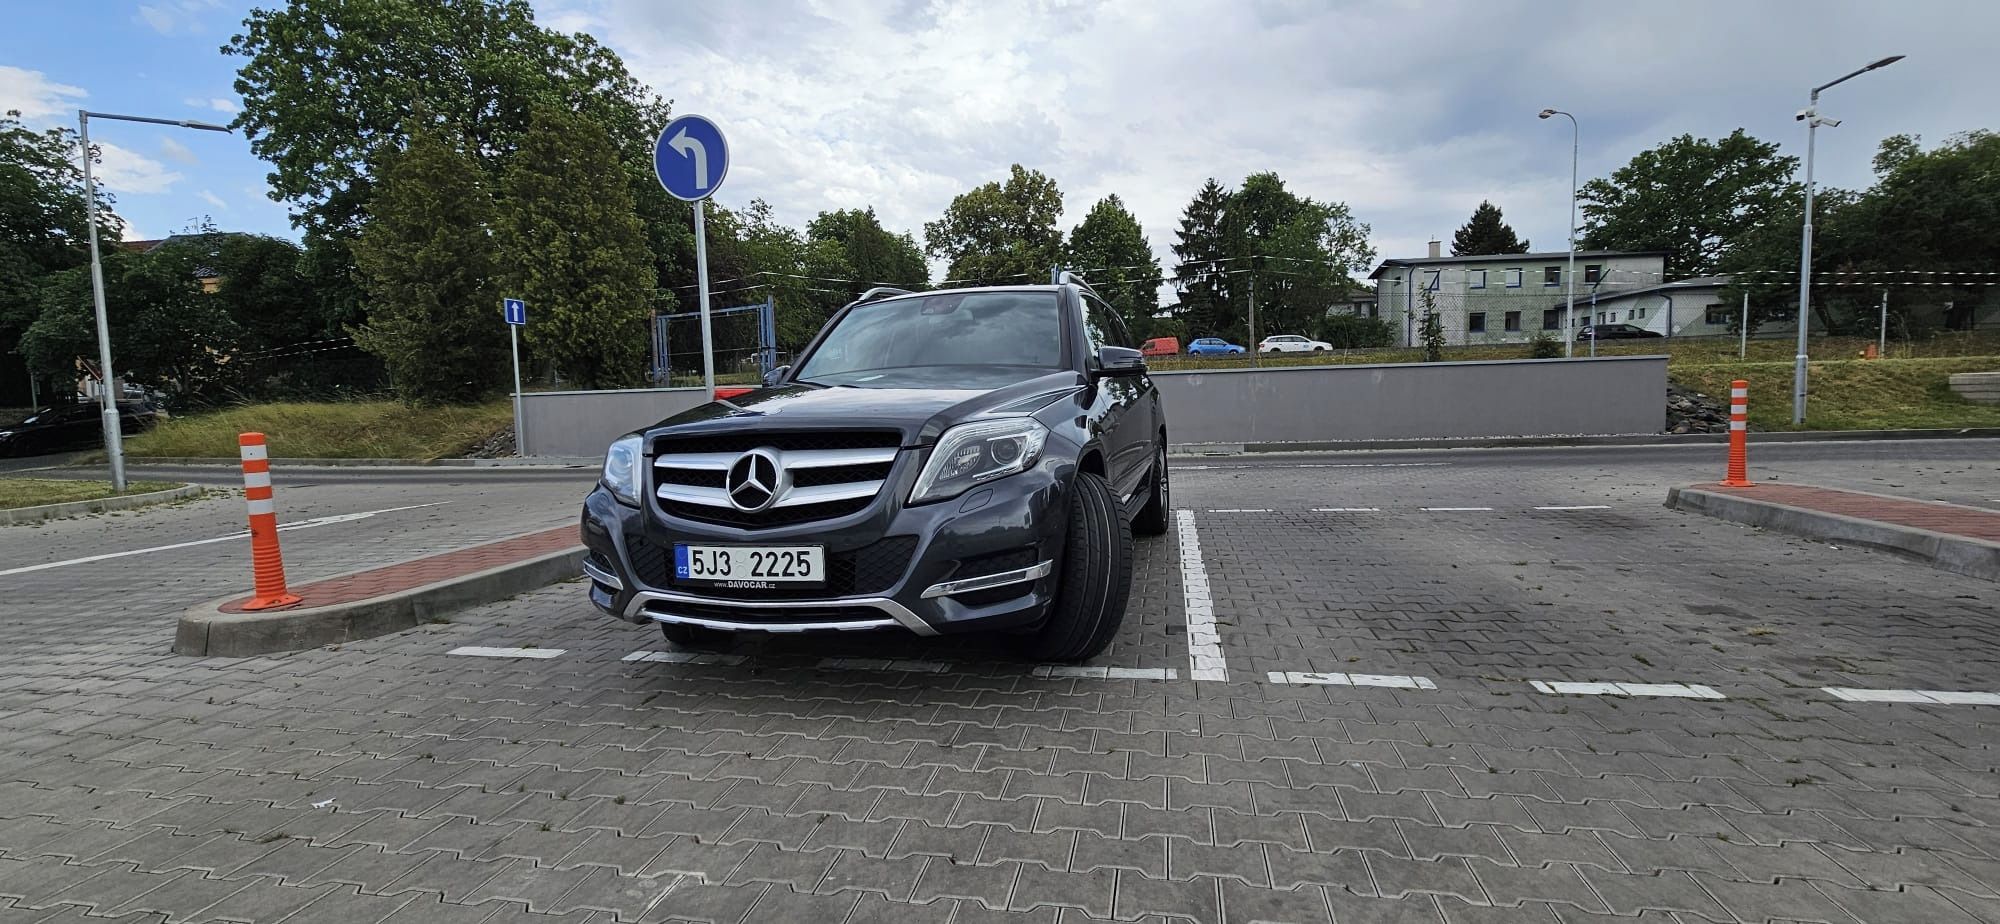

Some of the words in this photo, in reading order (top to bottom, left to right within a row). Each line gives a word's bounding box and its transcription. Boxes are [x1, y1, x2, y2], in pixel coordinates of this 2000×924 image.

[692, 550, 731, 576] 5J3
[750, 551, 811, 577] 2225
[677, 566, 688, 575] CZ
[713, 580, 776, 589] www.DAVOCAR.cz
